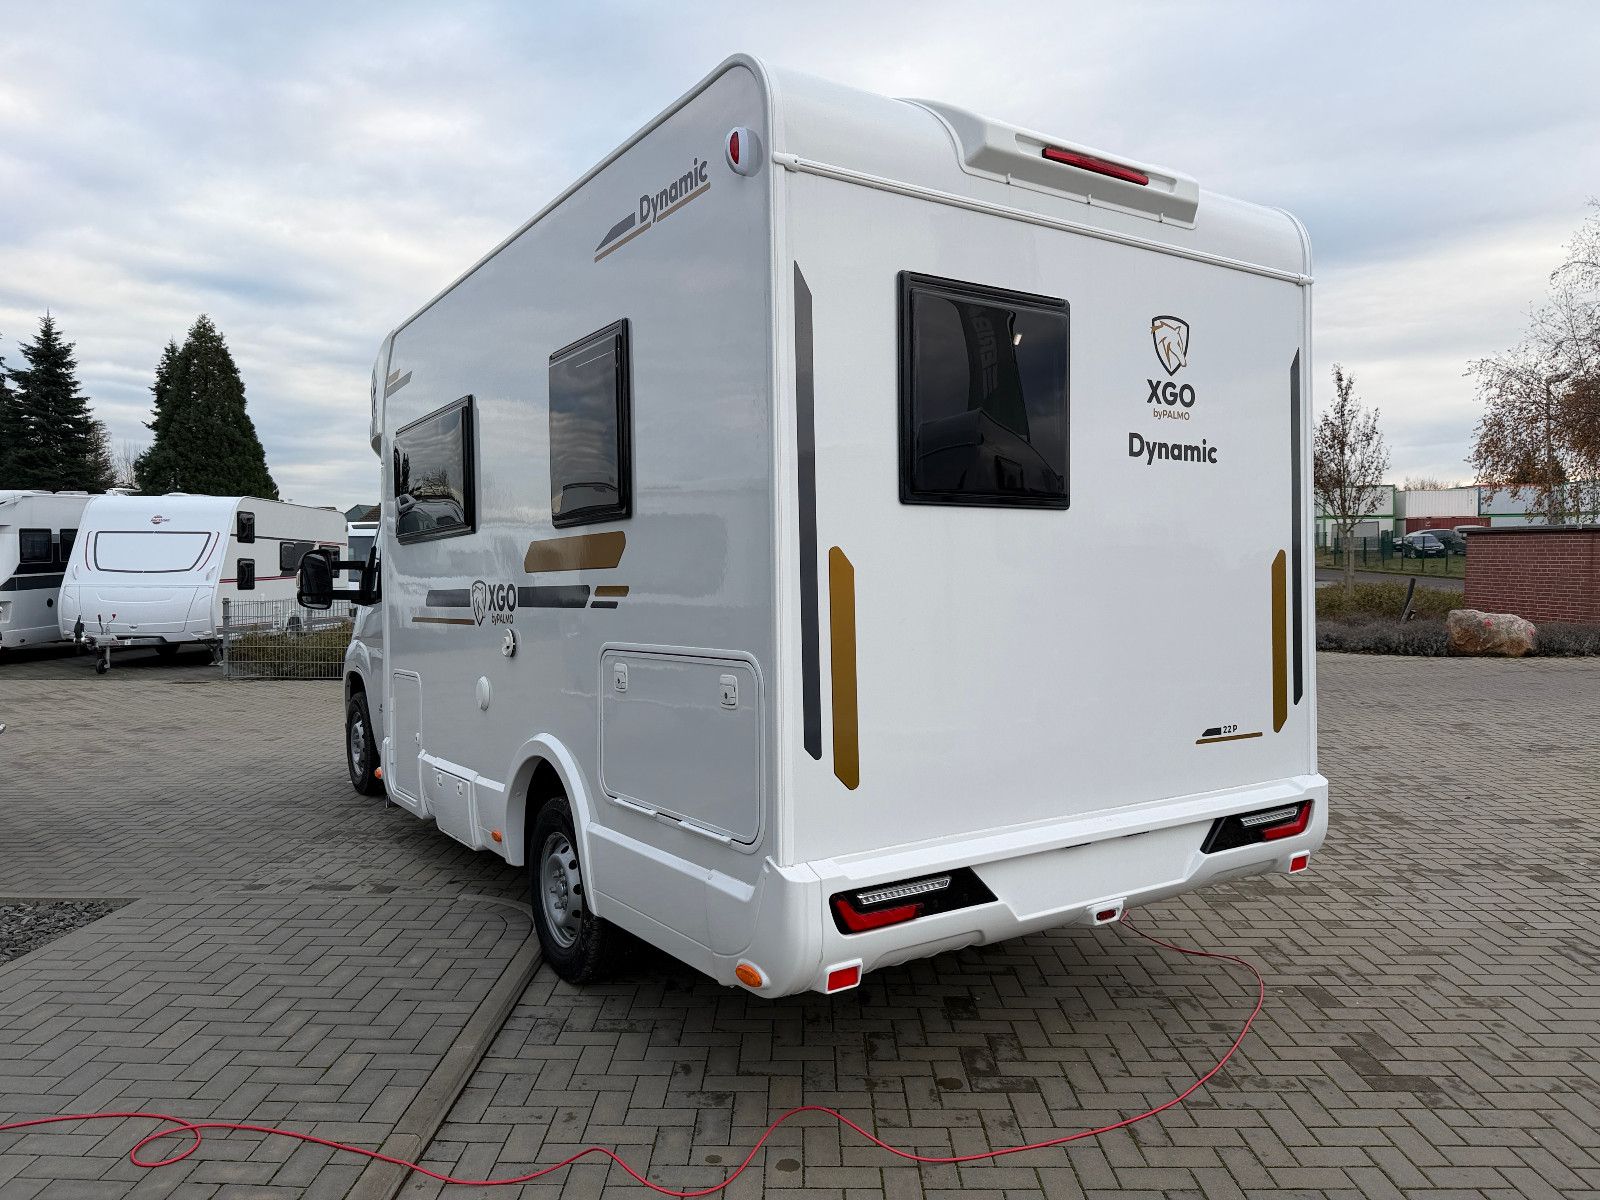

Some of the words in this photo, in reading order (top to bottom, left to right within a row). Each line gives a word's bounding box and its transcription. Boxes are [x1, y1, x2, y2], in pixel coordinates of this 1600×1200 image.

[639, 157, 708, 224] Dynamic
[1146, 379, 1196, 408] XGO
[1153, 408, 1190, 421] byPALMO
[1128, 432, 1218, 466] Dynamic
[487, 583, 517, 612] XGO
